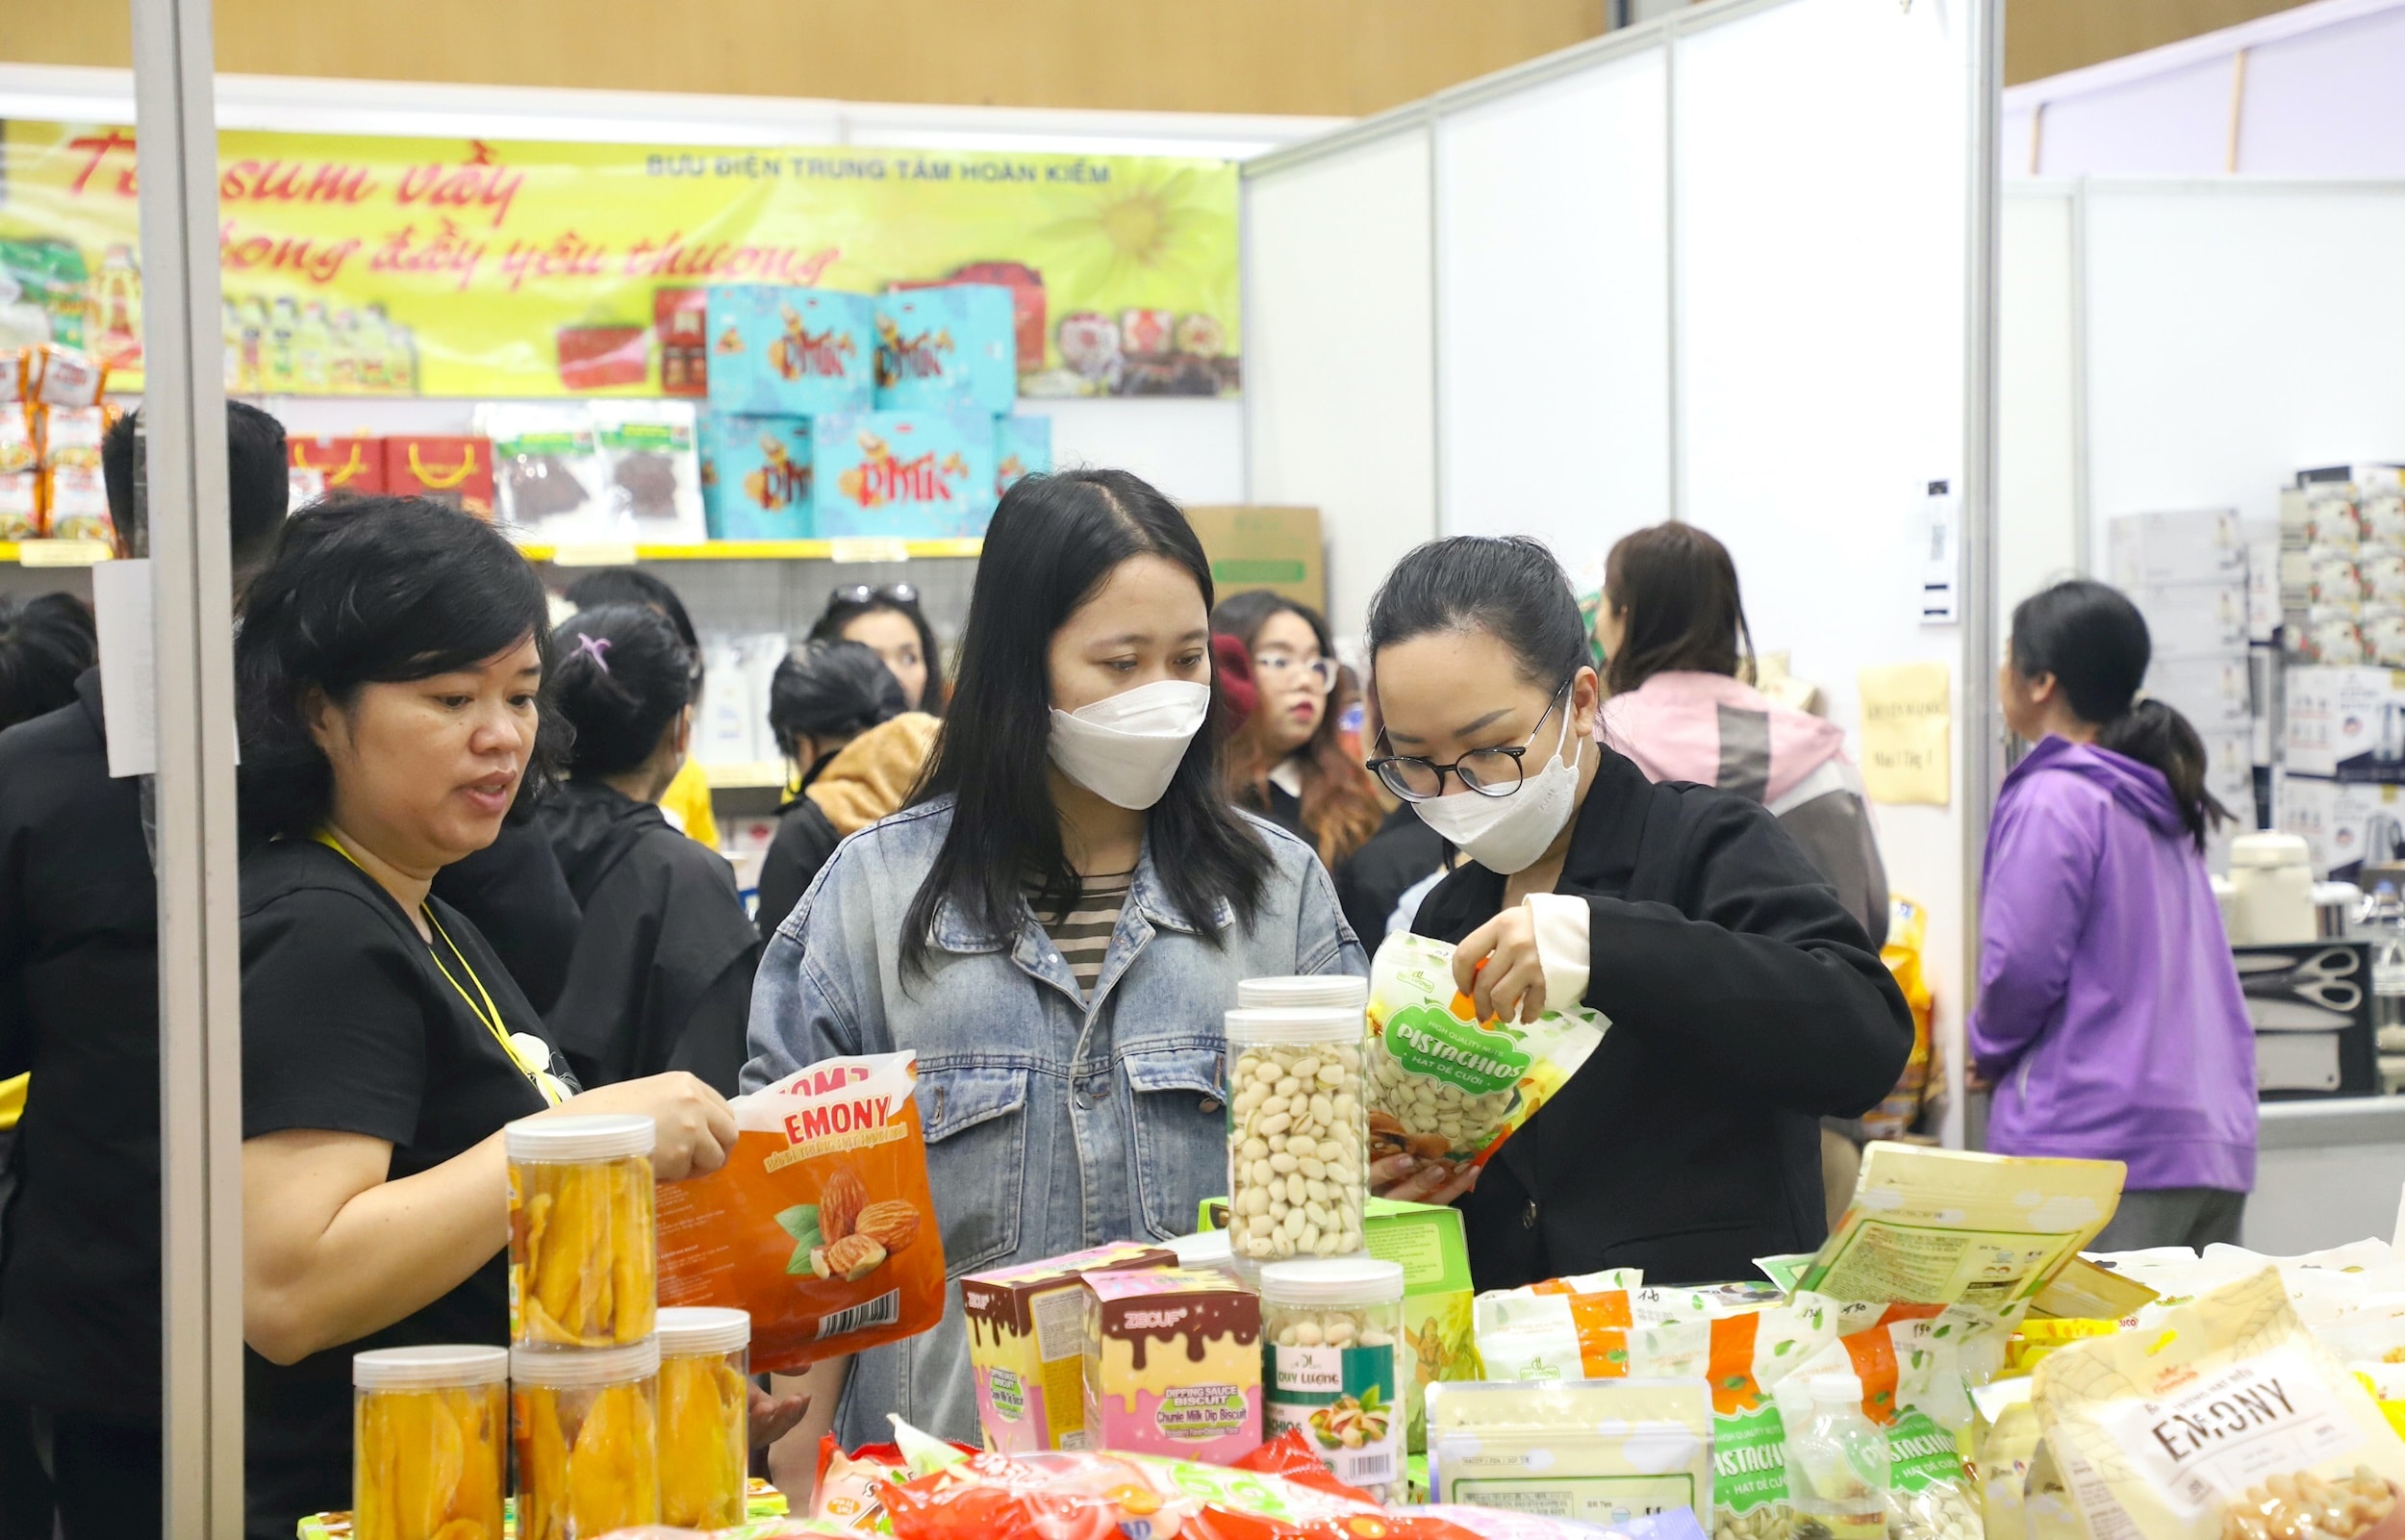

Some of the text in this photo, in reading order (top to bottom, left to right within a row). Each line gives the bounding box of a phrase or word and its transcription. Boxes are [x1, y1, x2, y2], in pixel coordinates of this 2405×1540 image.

[791, 157, 886, 181] TRUNG
[1428, 1021, 1504, 1057] HIGH QUALITY NUTS
[1396, 1022, 1525, 1079] PISTACHIOS
[784, 1096, 891, 1145] EMONY
[1124, 1312, 1180, 1329] ZECUF
[1278, 1372, 1297, 1383] DUY
[1166, 1385, 1238, 1399] DIPPING SAUCE
[1175, 1395, 1228, 1406] BISCUIT
[1186, 1409, 1202, 1422] Milk
[1204, 1409, 1218, 1424] Dip
[1220, 1407, 1247, 1421] Biscuit
[2152, 1377, 2294, 1462] EMONY
